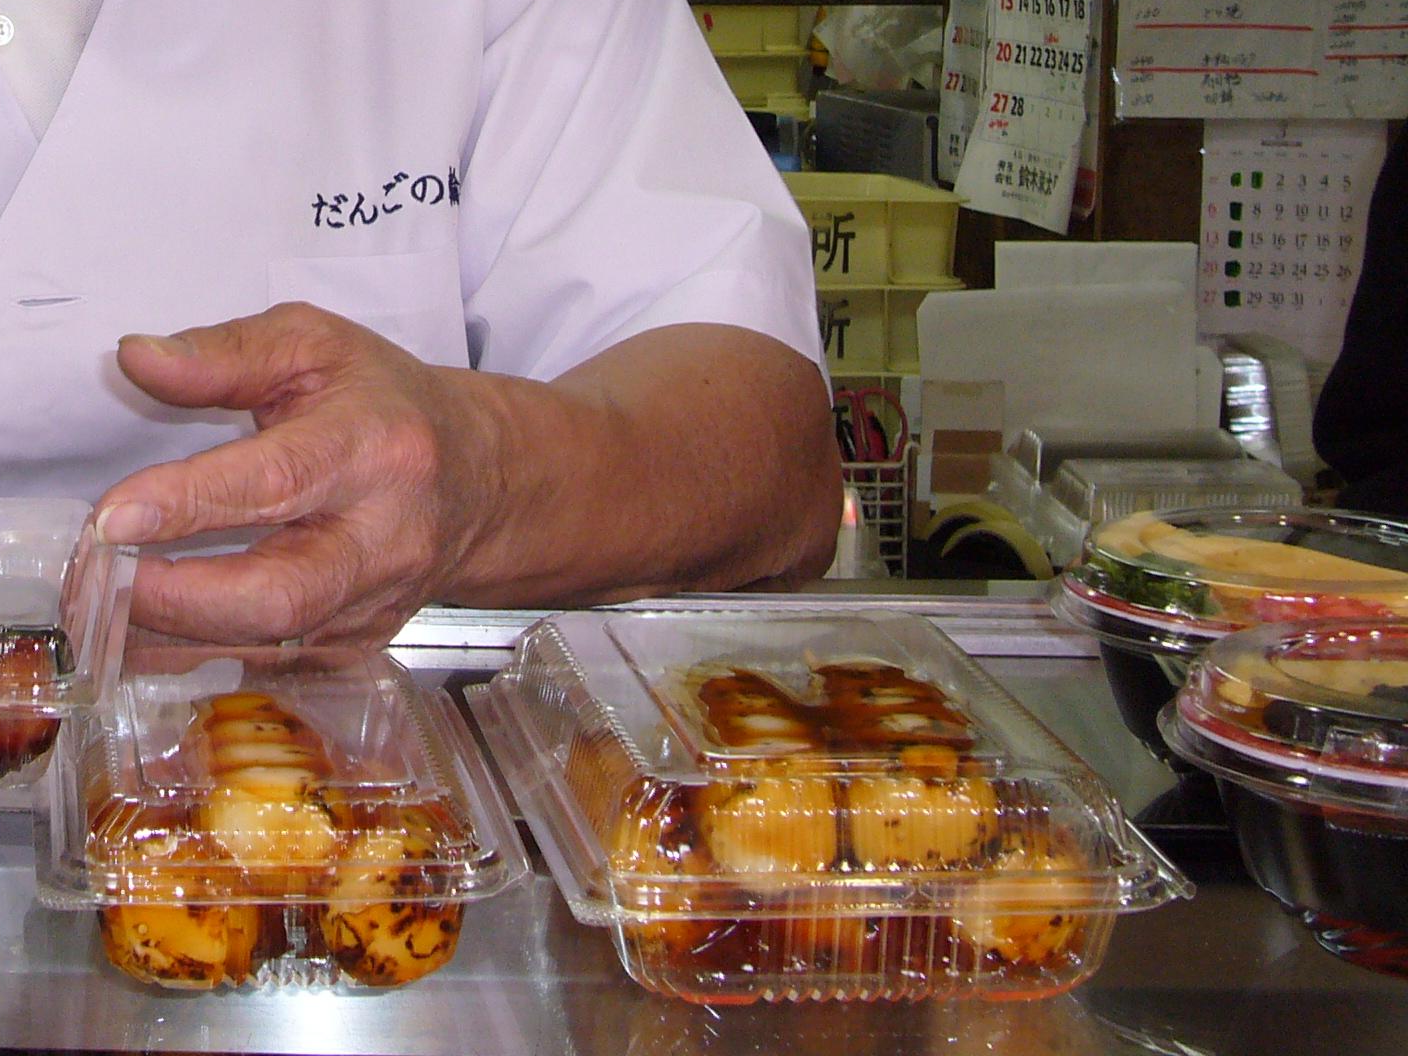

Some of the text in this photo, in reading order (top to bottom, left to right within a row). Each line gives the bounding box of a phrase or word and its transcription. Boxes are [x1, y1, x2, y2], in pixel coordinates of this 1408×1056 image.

[1074, 0, 1085, 19] 18
[996, 43, 1083, 74] 20 21 22 23 24 25
[945, 72, 960, 90] 27
[990, 93, 1008, 113] 27
[1011, 96, 1024, 116] 28
[1277, 174, 1284, 187] 2
[1320, 175, 1329, 187] 4
[1343, 175, 1351, 188] 5
[1252, 203, 1261, 215] 8
[1275, 204, 1284, 217] 9
[1296, 205, 1309, 217] 10
[1318, 206, 1329, 218] 11
[1340, 206, 1353, 219] 12
[811, 211, 856, 274] 所
[1251, 233, 1264, 244] 15
[1273, 233, 1286, 245] 16
[1295, 234, 1308, 246] 17
[1317, 234, 1330, 246] 18
[1248, 262, 1263, 275] 22
[1270, 263, 1285, 276] 23
[1292, 263, 1307, 277] 24
[1314, 264, 1330, 277] 25
[1247, 292, 1263, 304] 29
[1267, 292, 1284, 305] 30
[1292, 292, 1304, 306] 31
